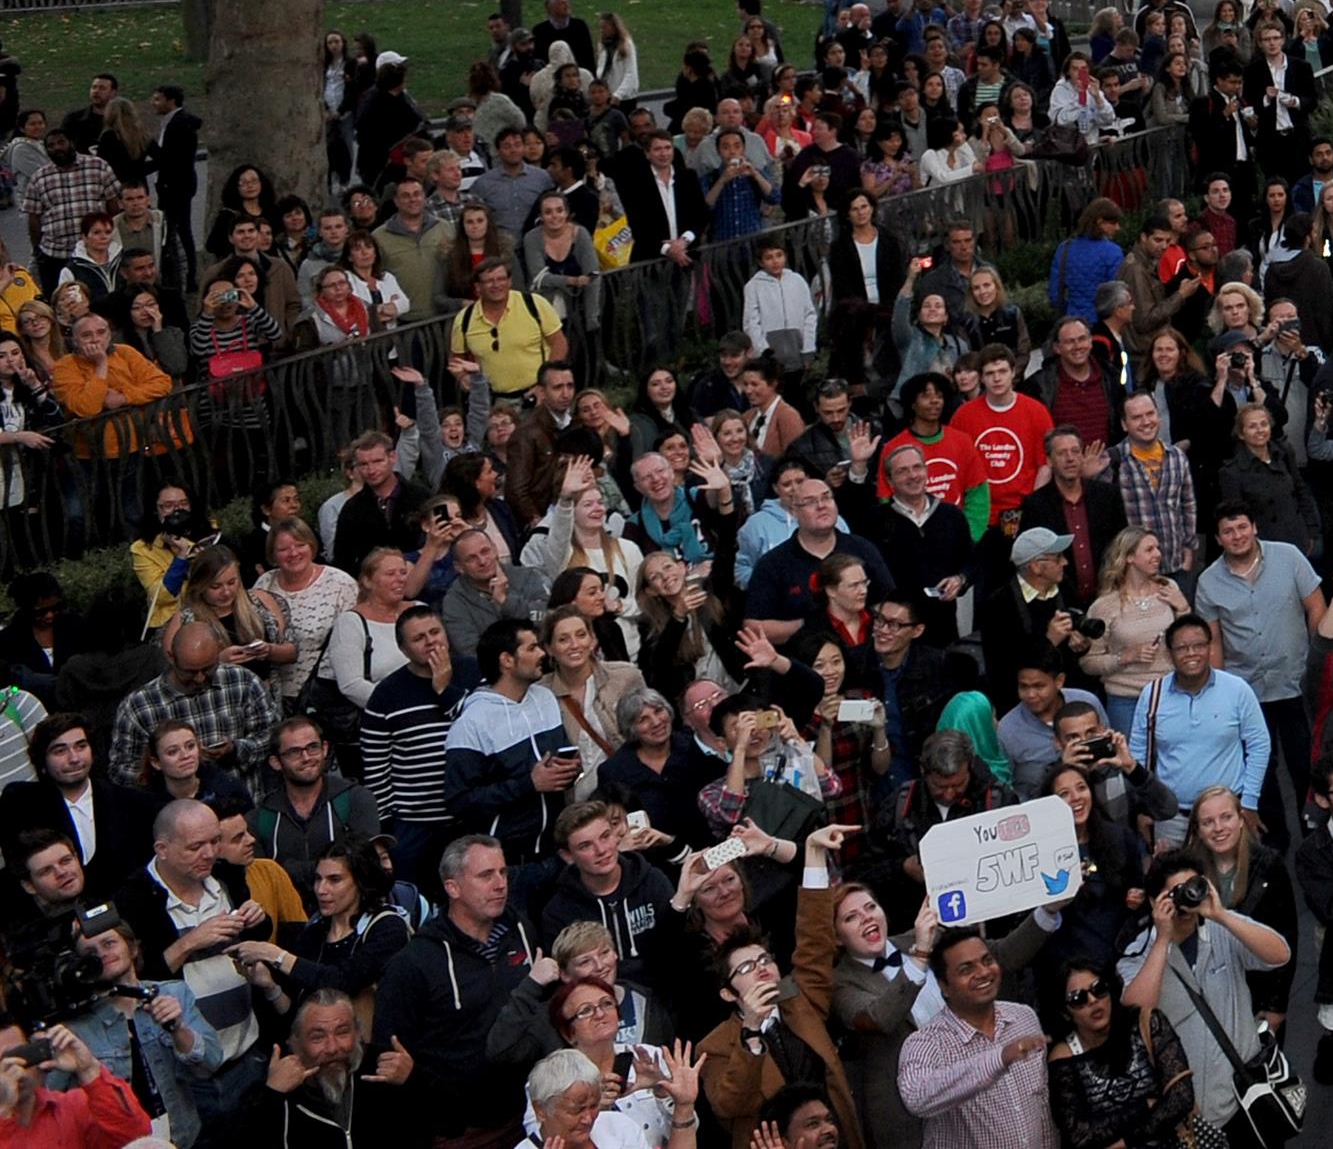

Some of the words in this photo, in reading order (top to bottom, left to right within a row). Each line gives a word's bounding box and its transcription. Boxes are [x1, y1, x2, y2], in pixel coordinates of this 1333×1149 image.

[979, 443, 991, 451] The
[992, 443, 1017, 451] London
[985, 452, 1011, 460] Comedy
[976, 841, 1040, 893] 5WF
